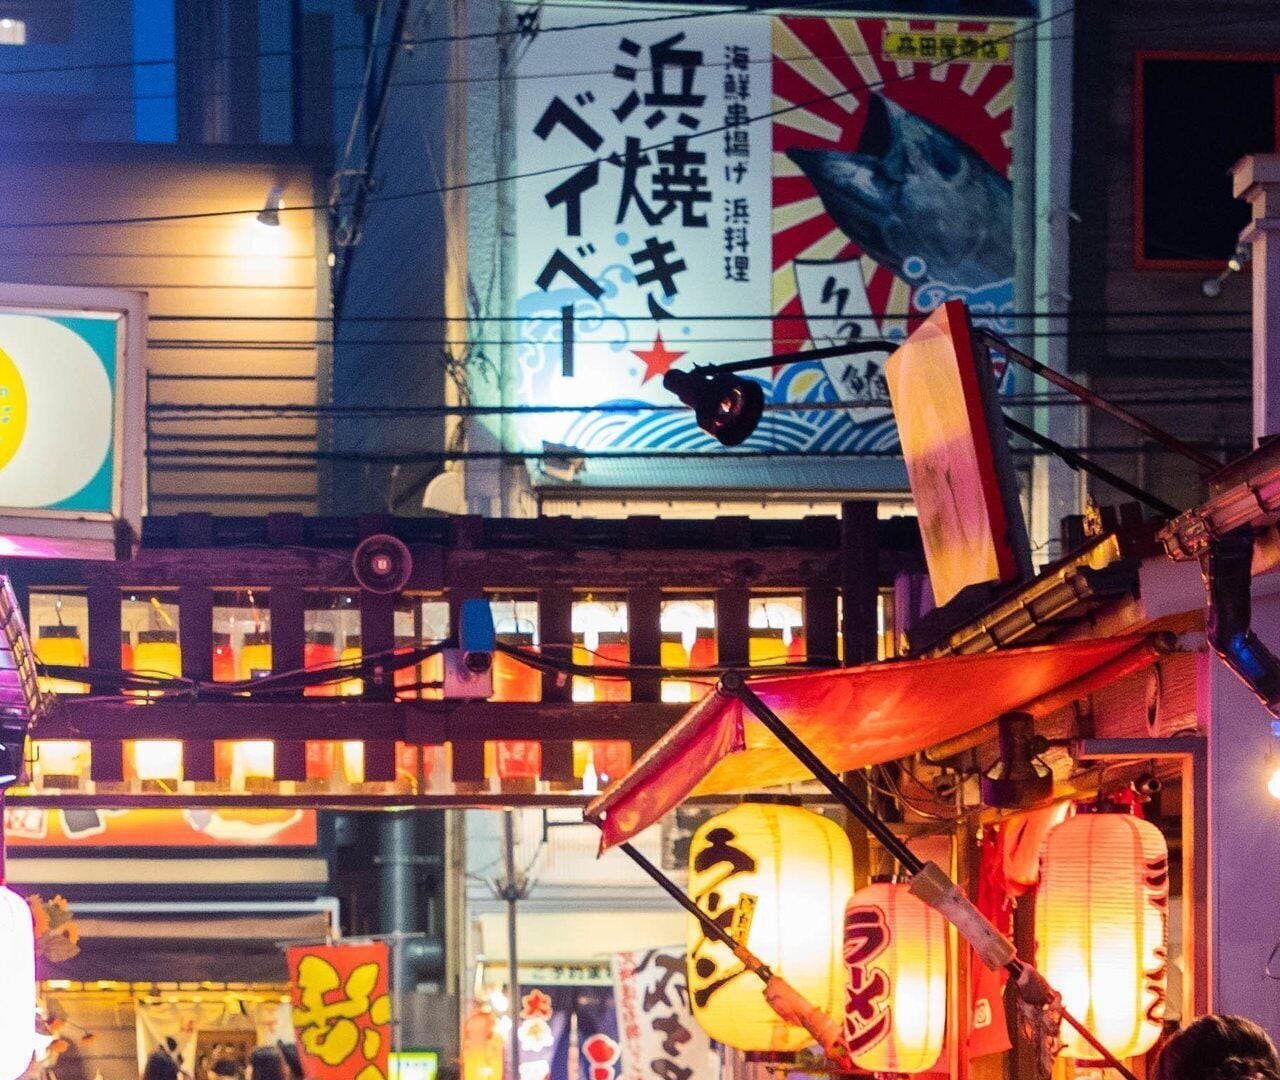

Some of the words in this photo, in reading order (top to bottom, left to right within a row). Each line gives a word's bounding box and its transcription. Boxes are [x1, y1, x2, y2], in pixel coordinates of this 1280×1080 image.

[611, 32, 714, 320] 浜焼き
[724, 45, 750, 184] 海鮮串揚げ
[533, 91, 605, 377] ベイベー
[724, 198, 750, 283] 浜料理
[843, 906, 890, 1055] ラーメン
